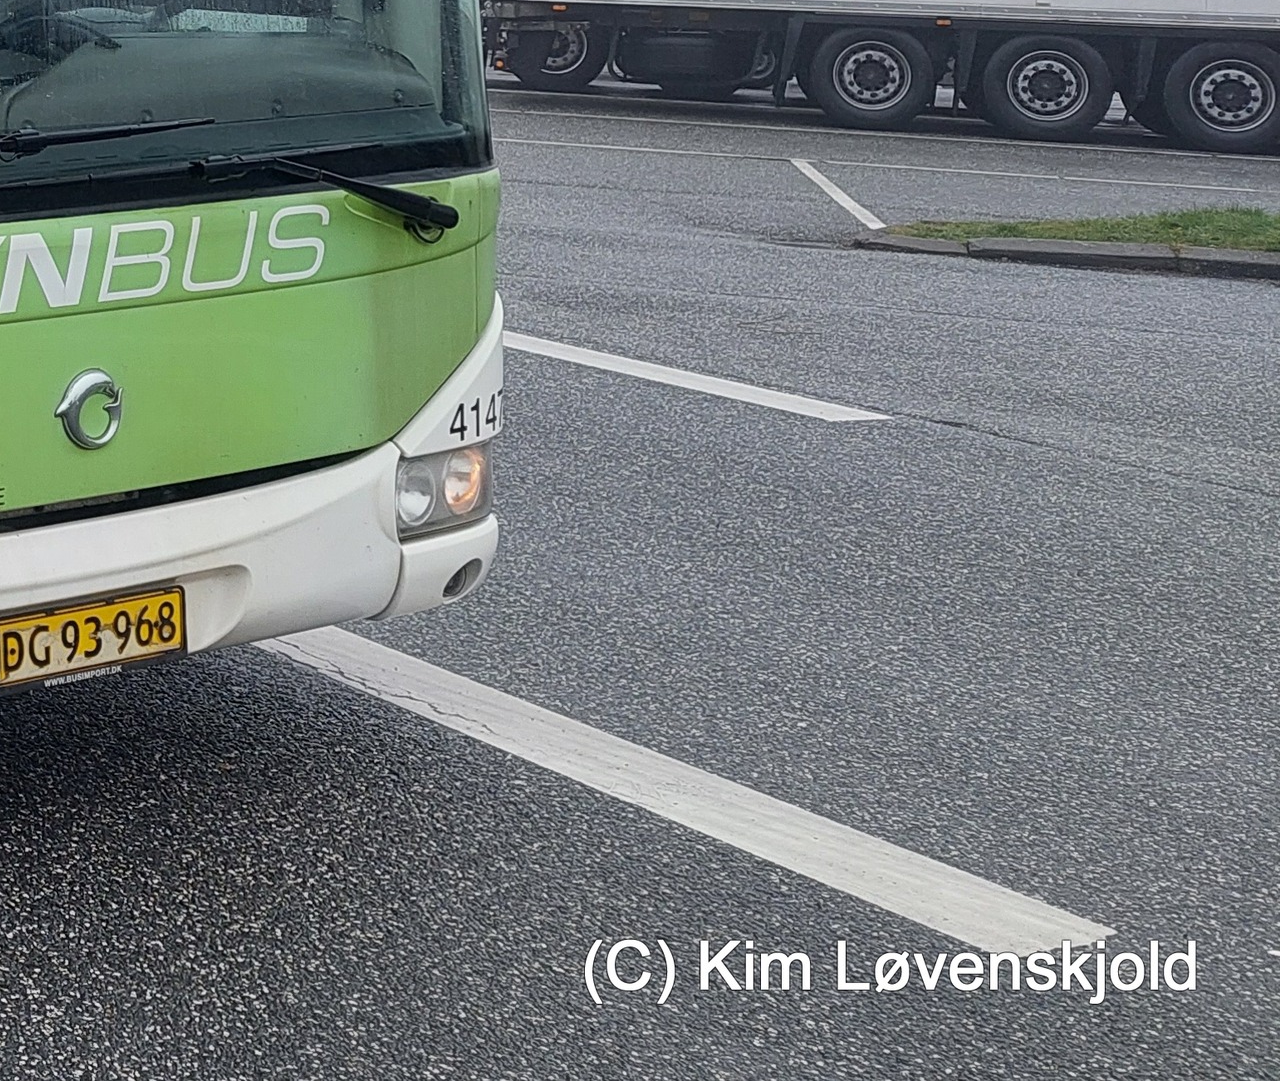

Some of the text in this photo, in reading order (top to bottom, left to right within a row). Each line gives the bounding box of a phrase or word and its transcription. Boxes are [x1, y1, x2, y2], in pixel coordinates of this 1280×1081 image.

[3, 626, 50, 671] DG
[61, 617, 102, 663] 93
[113, 602, 176, 654] 968
[44, 665, 122, 688] WWW.BUSIMPORT.DK
